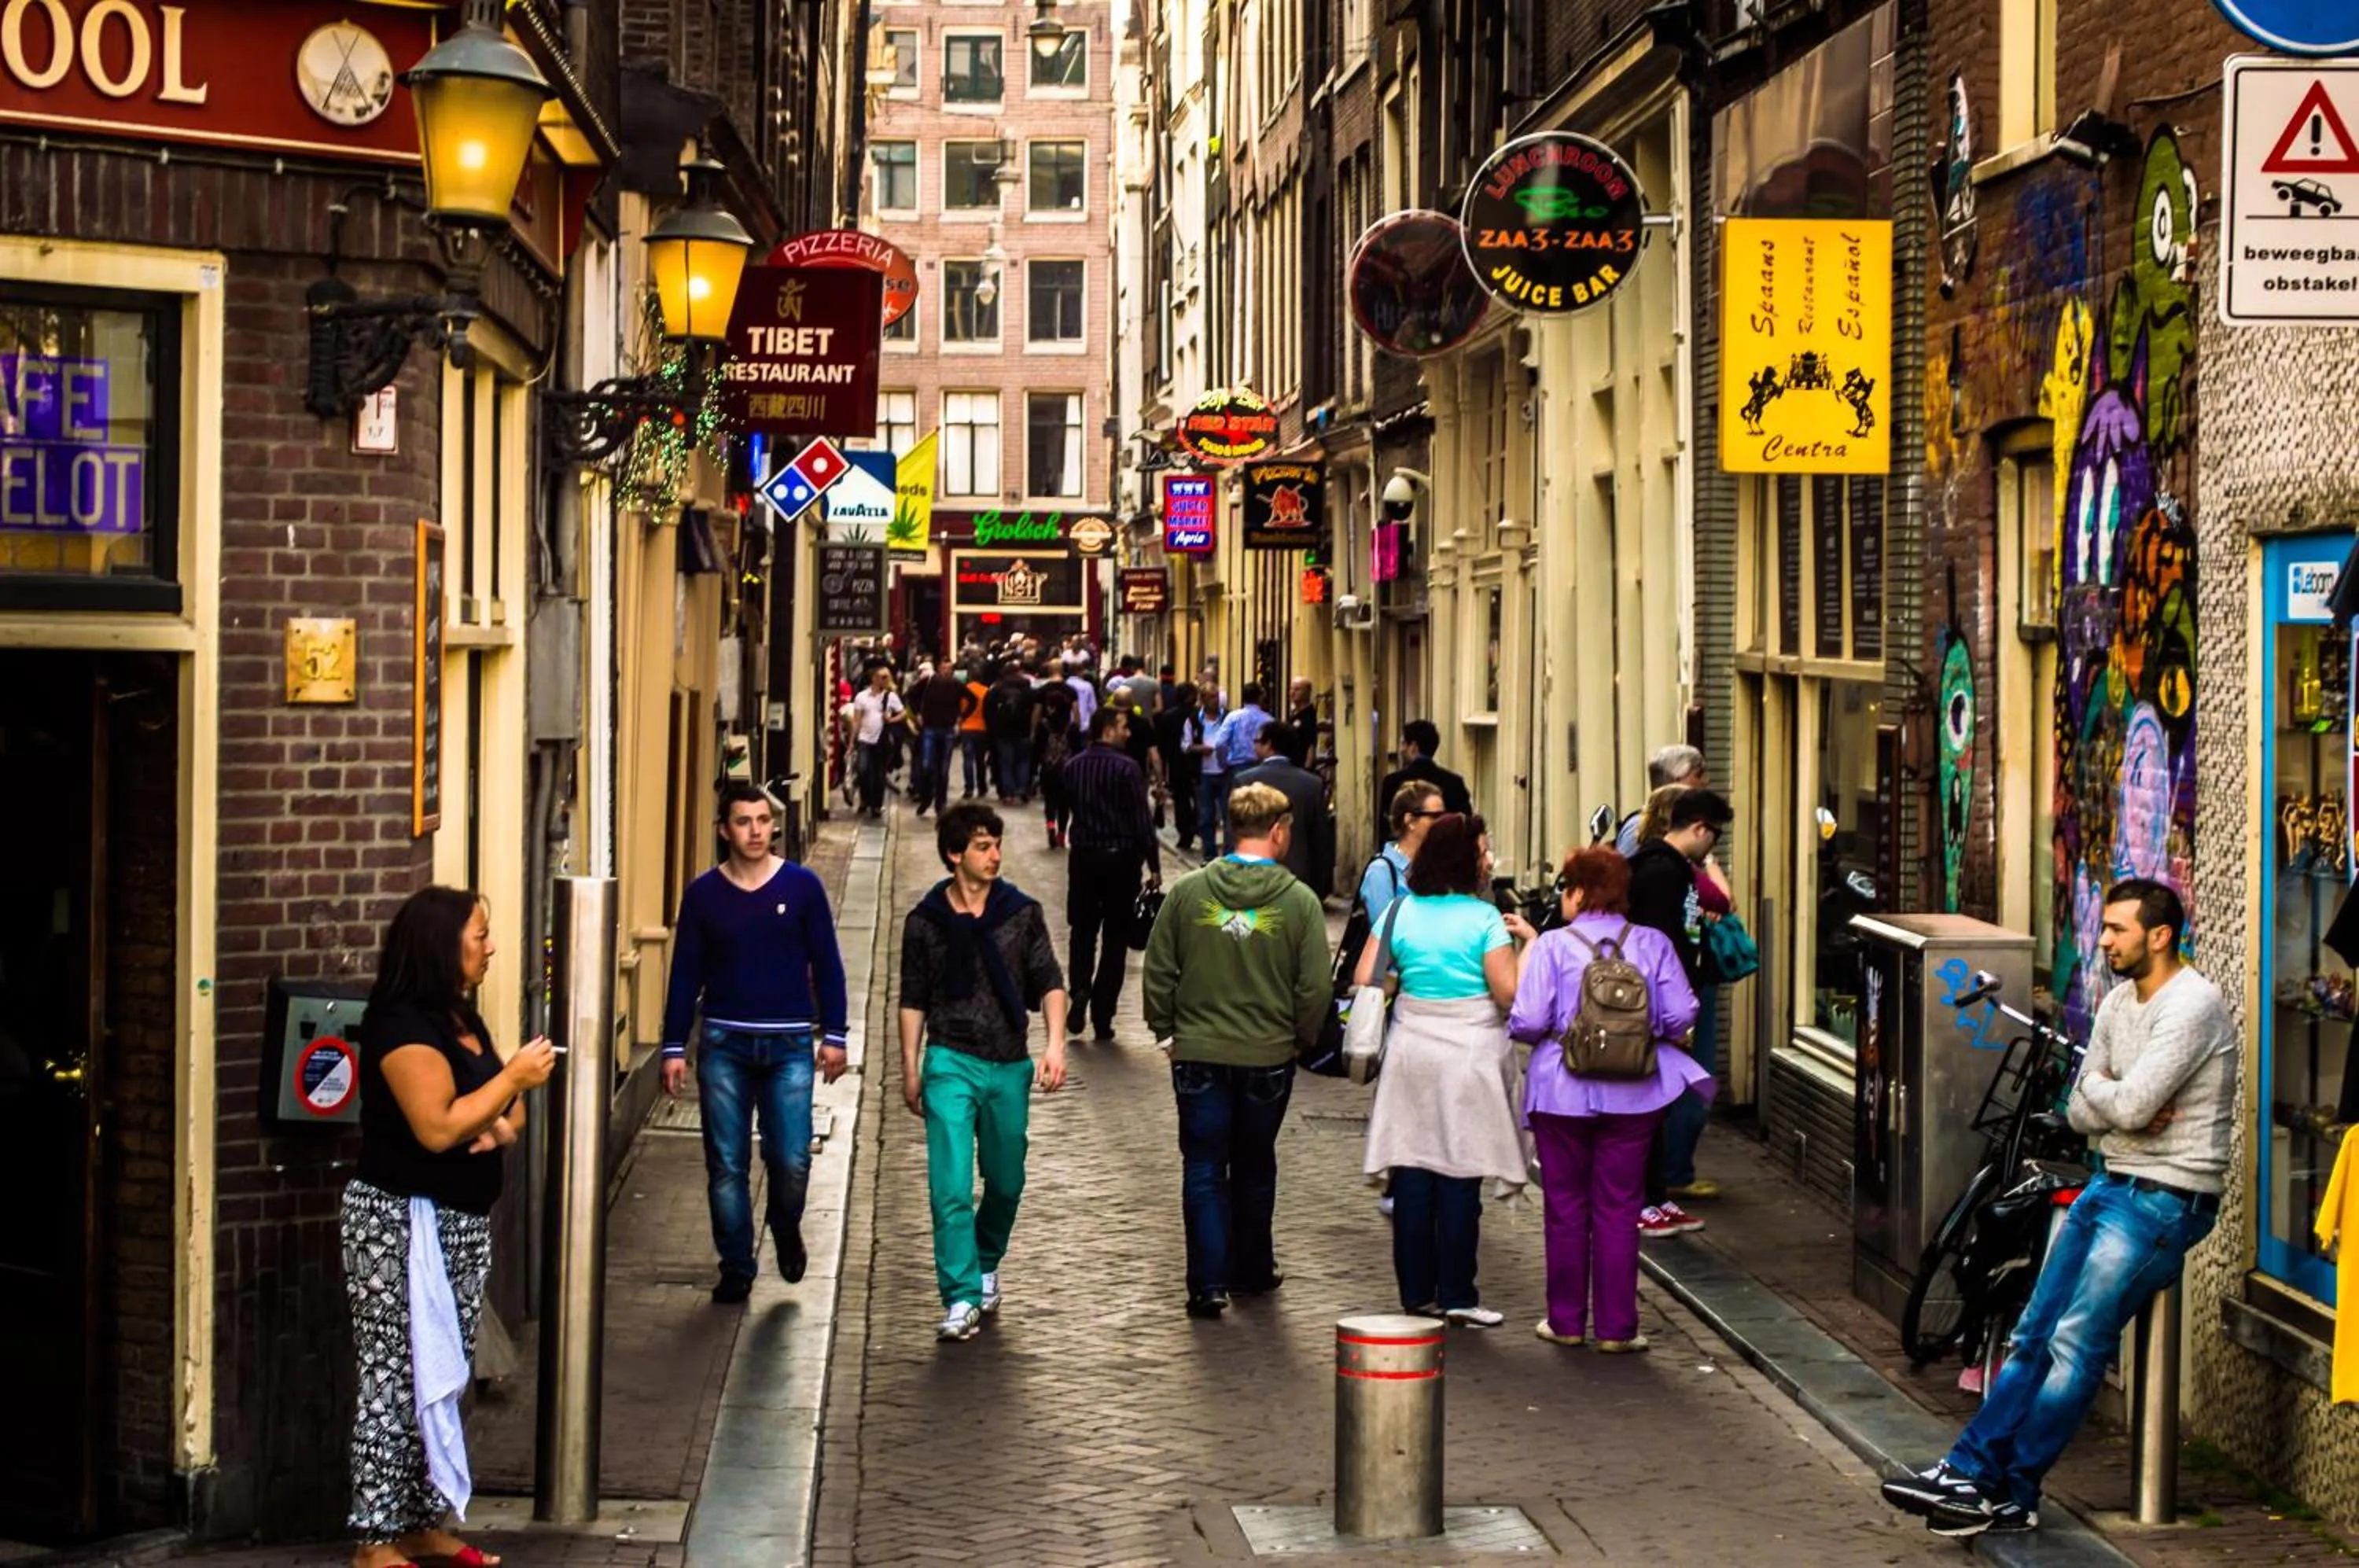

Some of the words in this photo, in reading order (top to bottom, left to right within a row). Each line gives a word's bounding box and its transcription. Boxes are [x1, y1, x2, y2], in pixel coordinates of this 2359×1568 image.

[1, 0, 208, 104] OOL
[1485, 138, 1629, 201] LUNCHROOM
[783, 232, 893, 267] PIZZERIA
[1492, 264, 1562, 307] JUICE
[1572, 263, 1620, 304] BAR
[1750, 239, 1779, 337] Spaans
[1837, 232, 1864, 340] Español
[2263, 275, 2357, 290] obstakel
[747, 326, 834, 356] TIBET
[722, 363, 856, 384] RESTAURANT
[1188, 414, 1225, 431] RED
[1227, 415, 1276, 432] STAR
[1762, 434, 1849, 462] Centra
[2, 447, 139, 528] ELOT
[896, 483, 927, 497] eds
[833, 502, 889, 517] LAVAZZA
[973, 508, 1062, 546] Grolsch
[304, 640, 343, 681] 52
